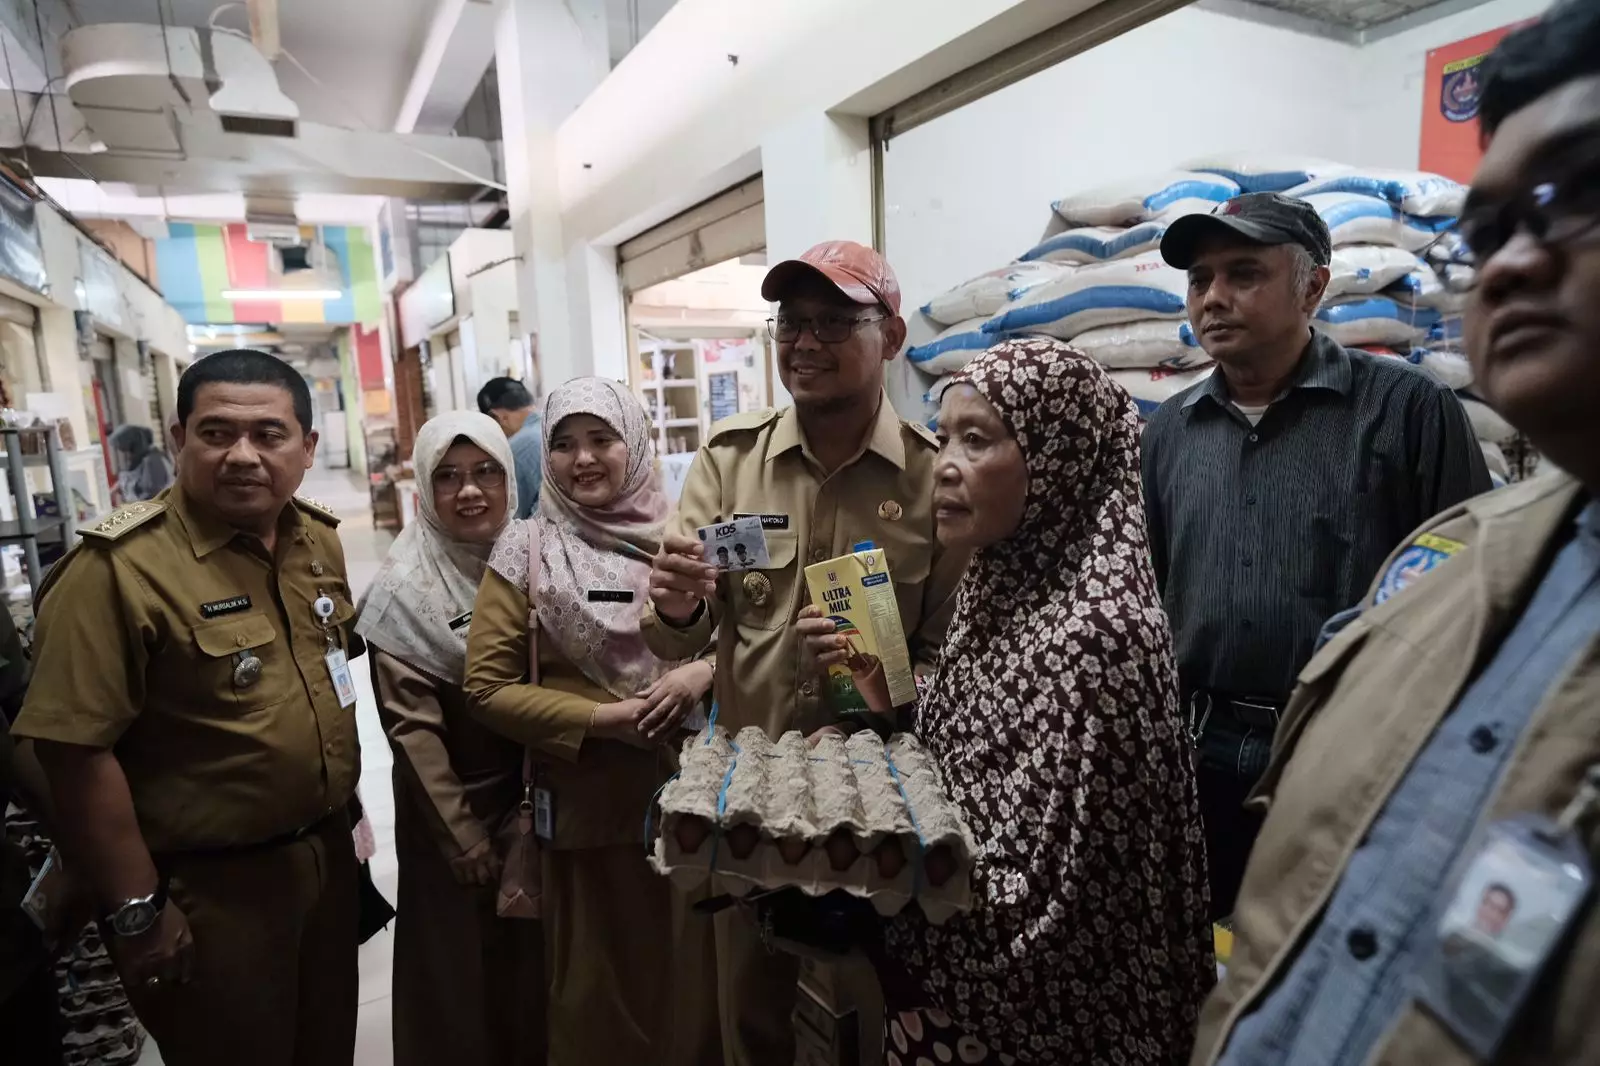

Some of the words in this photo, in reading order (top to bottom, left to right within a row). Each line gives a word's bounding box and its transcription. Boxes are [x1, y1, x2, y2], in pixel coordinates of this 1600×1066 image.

[715, 523, 737, 537] KDS
[822, 586, 852, 602] ULTRA
[828, 599, 852, 615] MILK
